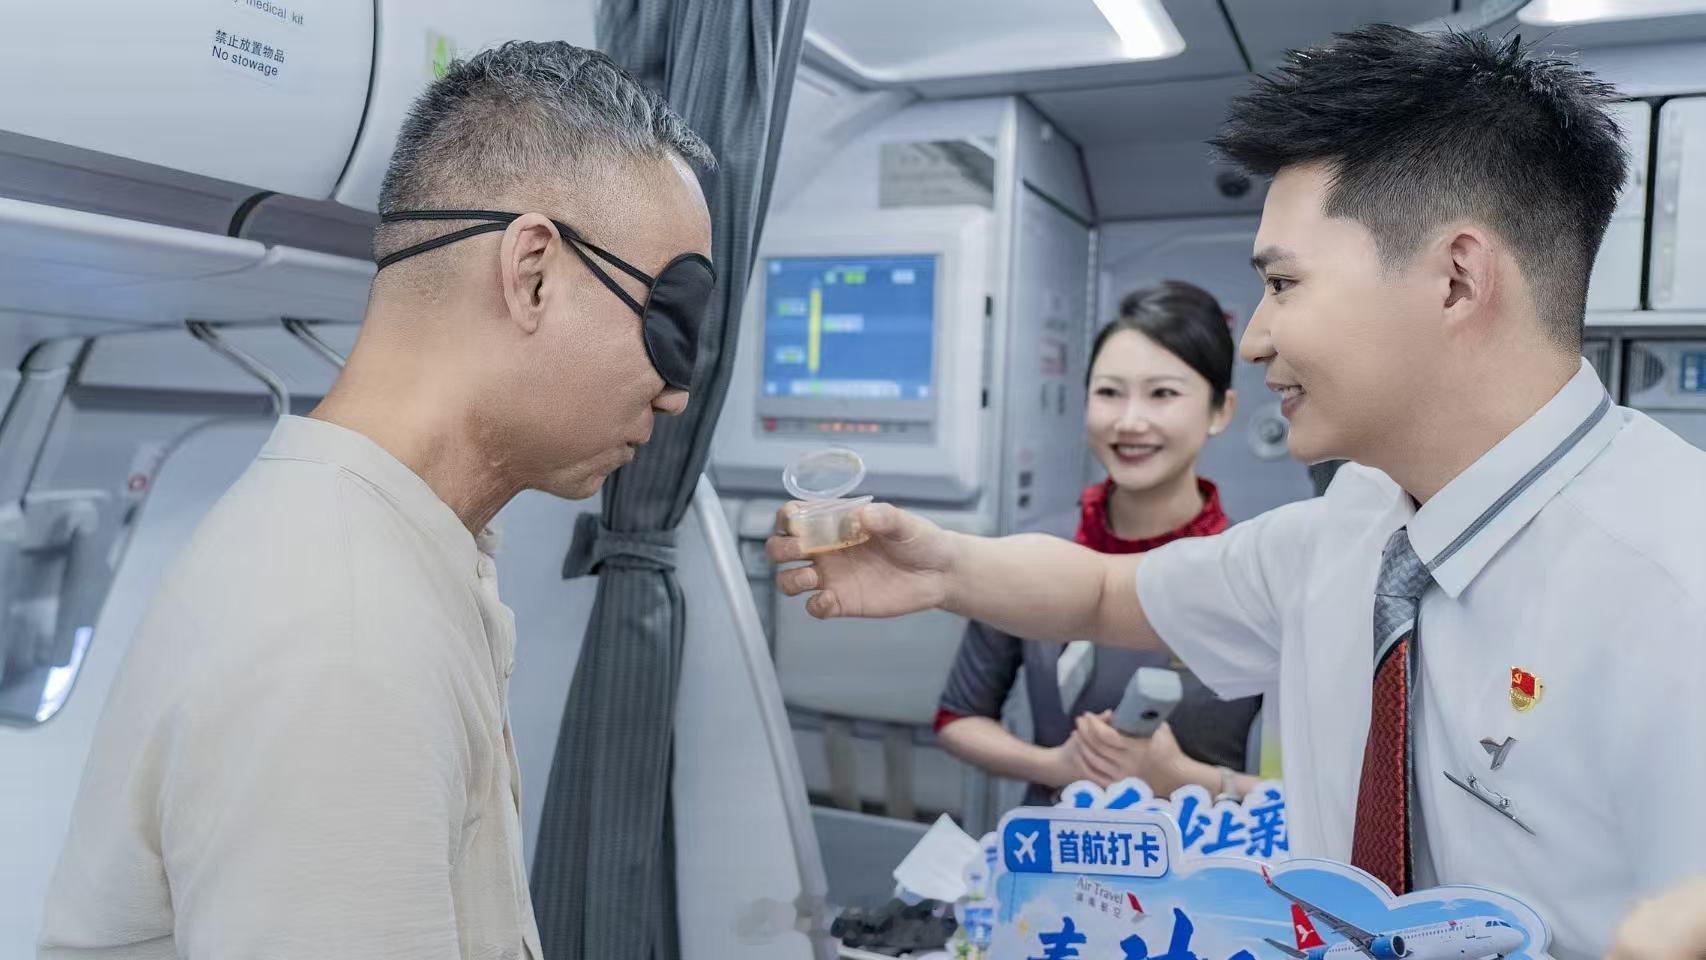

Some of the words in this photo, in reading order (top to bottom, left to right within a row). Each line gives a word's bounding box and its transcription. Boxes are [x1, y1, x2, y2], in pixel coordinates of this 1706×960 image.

[246, 0, 287, 19] medical
[292, 11, 304, 25] kit
[212, 45, 229, 61] No
[231, 54, 278, 77] stowage
[215, 29, 285, 63] 禁止放置物品
[1057, 829, 1160, 868] 首航打卡
[1077, 876, 1092, 891] Air
[1094, 882, 1123, 905] Travel
